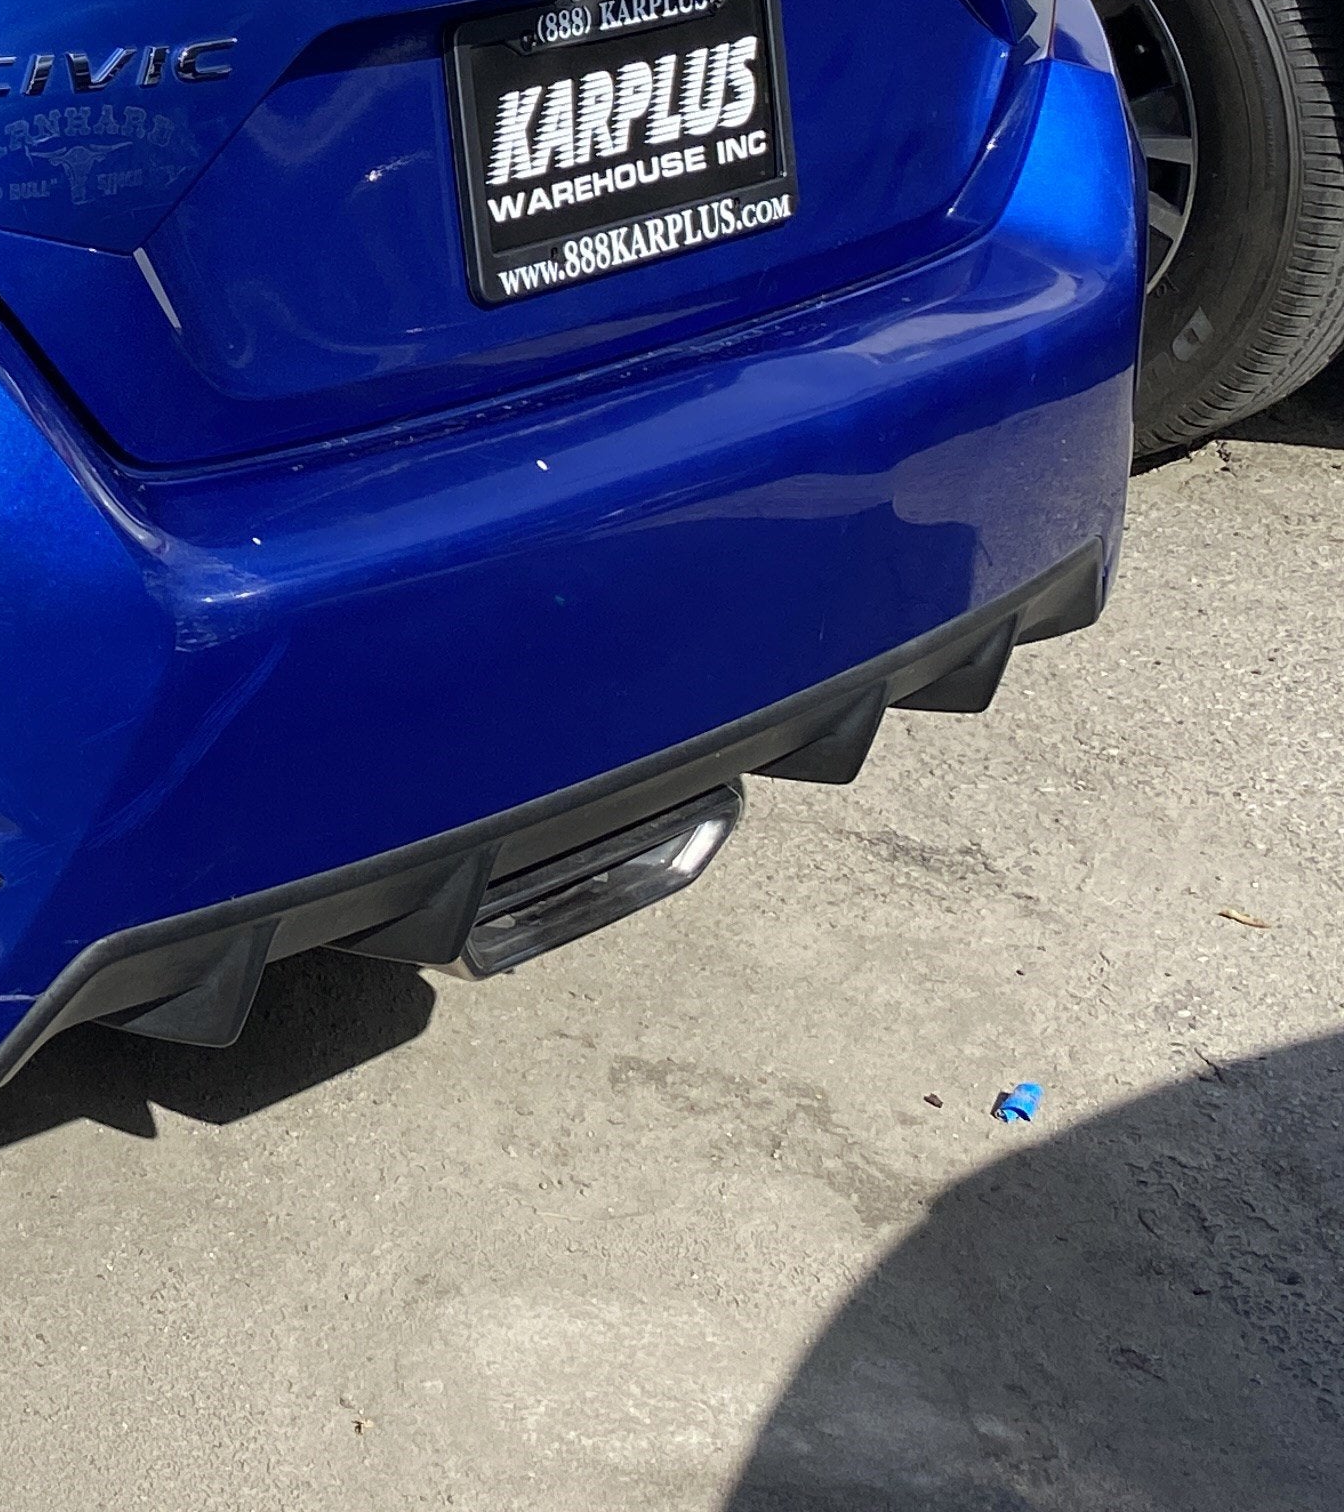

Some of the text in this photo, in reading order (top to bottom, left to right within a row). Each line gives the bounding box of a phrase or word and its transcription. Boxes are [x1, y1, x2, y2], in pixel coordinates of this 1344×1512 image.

[537, 5, 592, 44] (888)
[485, 35, 759, 186] KARPLUS
[486, 129, 768, 224] WAREHOUSE INC
